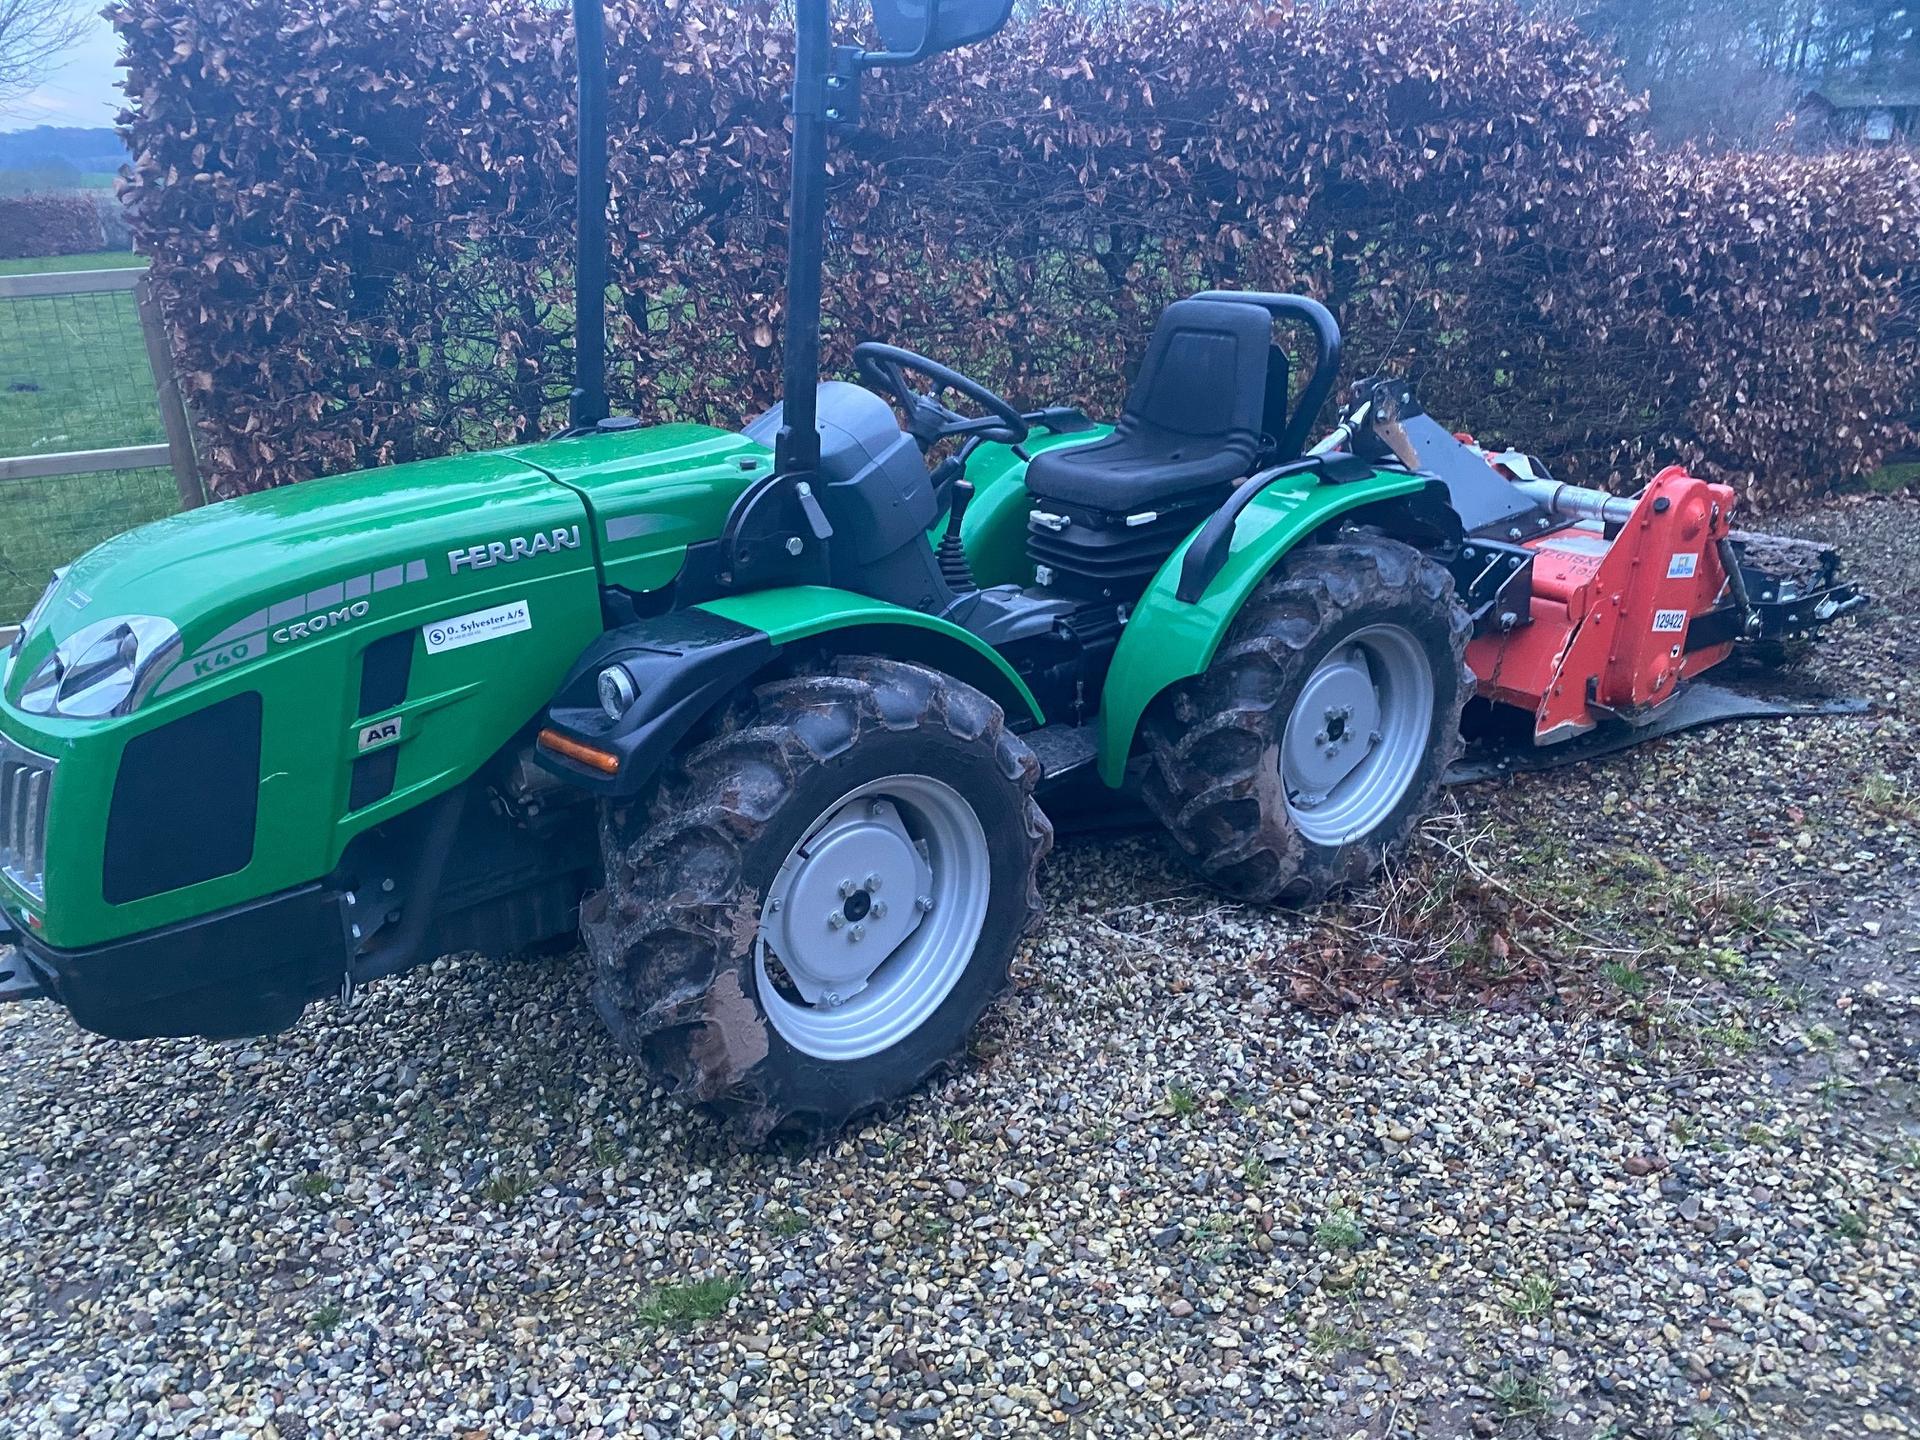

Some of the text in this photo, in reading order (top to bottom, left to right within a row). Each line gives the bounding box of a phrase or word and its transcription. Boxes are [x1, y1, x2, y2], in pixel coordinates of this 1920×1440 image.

[448, 525, 580, 575] FERRARI
[272, 600, 370, 644] CROMO
[460, 614, 505, 633] Sylvester
[507, 608, 524, 620] A/S
[1655, 613, 1684, 629] 129422
[192, 643, 249, 677] K40
[367, 725, 396, 743] AR
